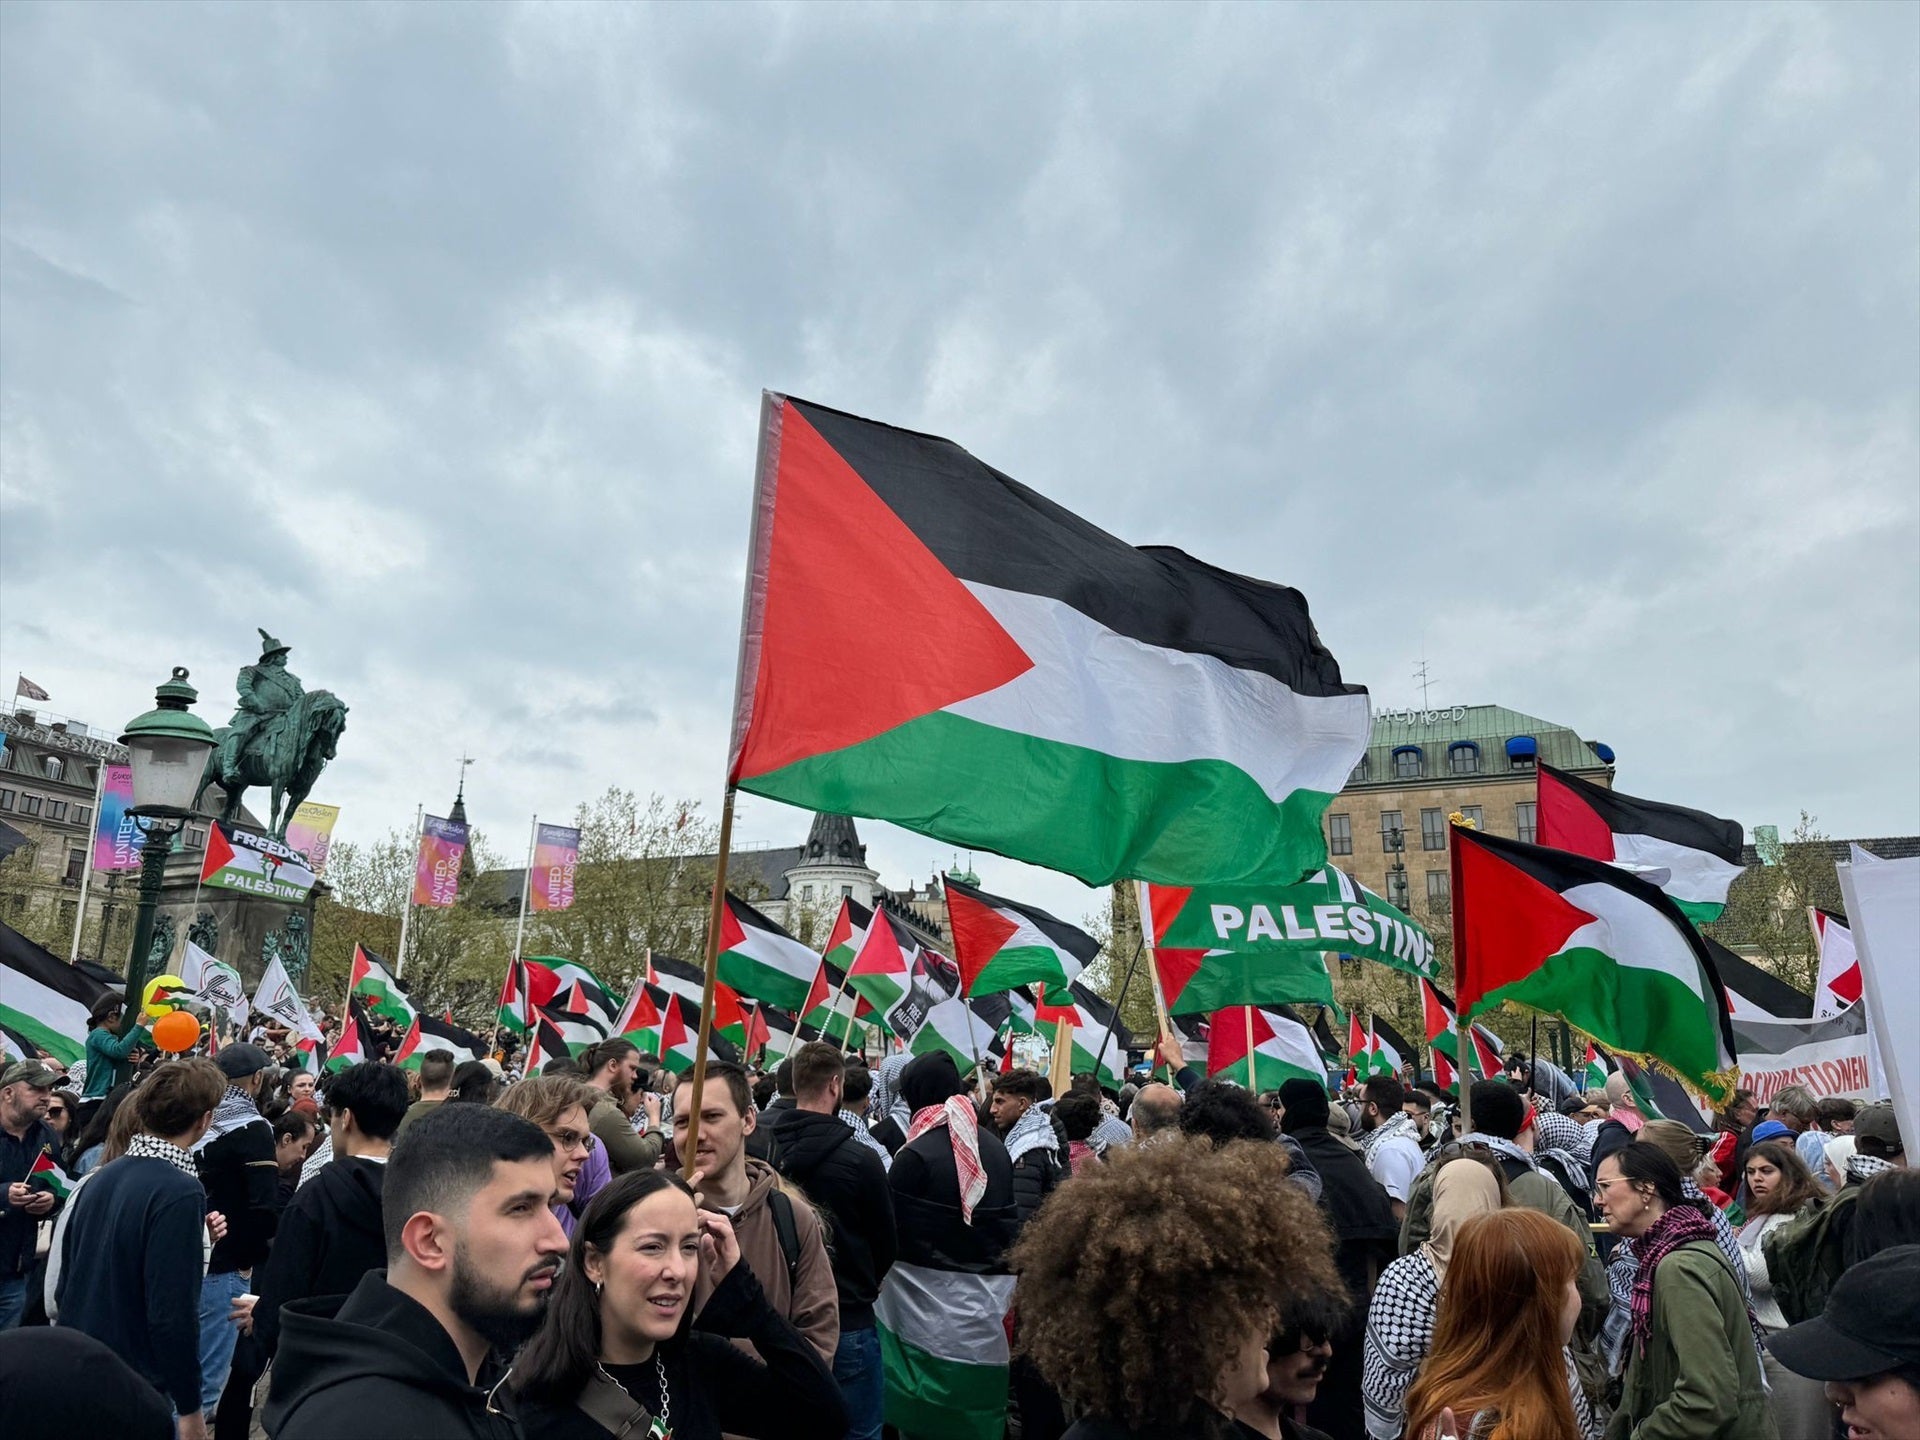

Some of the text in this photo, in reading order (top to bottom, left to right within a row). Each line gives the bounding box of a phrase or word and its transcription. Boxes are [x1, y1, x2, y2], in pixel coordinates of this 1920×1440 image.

[113, 815, 134, 865] UNITED
[312, 831, 330, 874] MUSIC
[223, 872, 306, 899] PALESTINE
[430, 859, 448, 903] UNITED
[445, 847, 461, 887] MUSIC
[548, 866, 562, 907] UNITED
[561, 853, 577, 908] BY MUSIC
[440, 888, 454, 904] BY
[1210, 904, 1435, 974] PALESTINE
[906, 1002, 923, 1023] FREE
